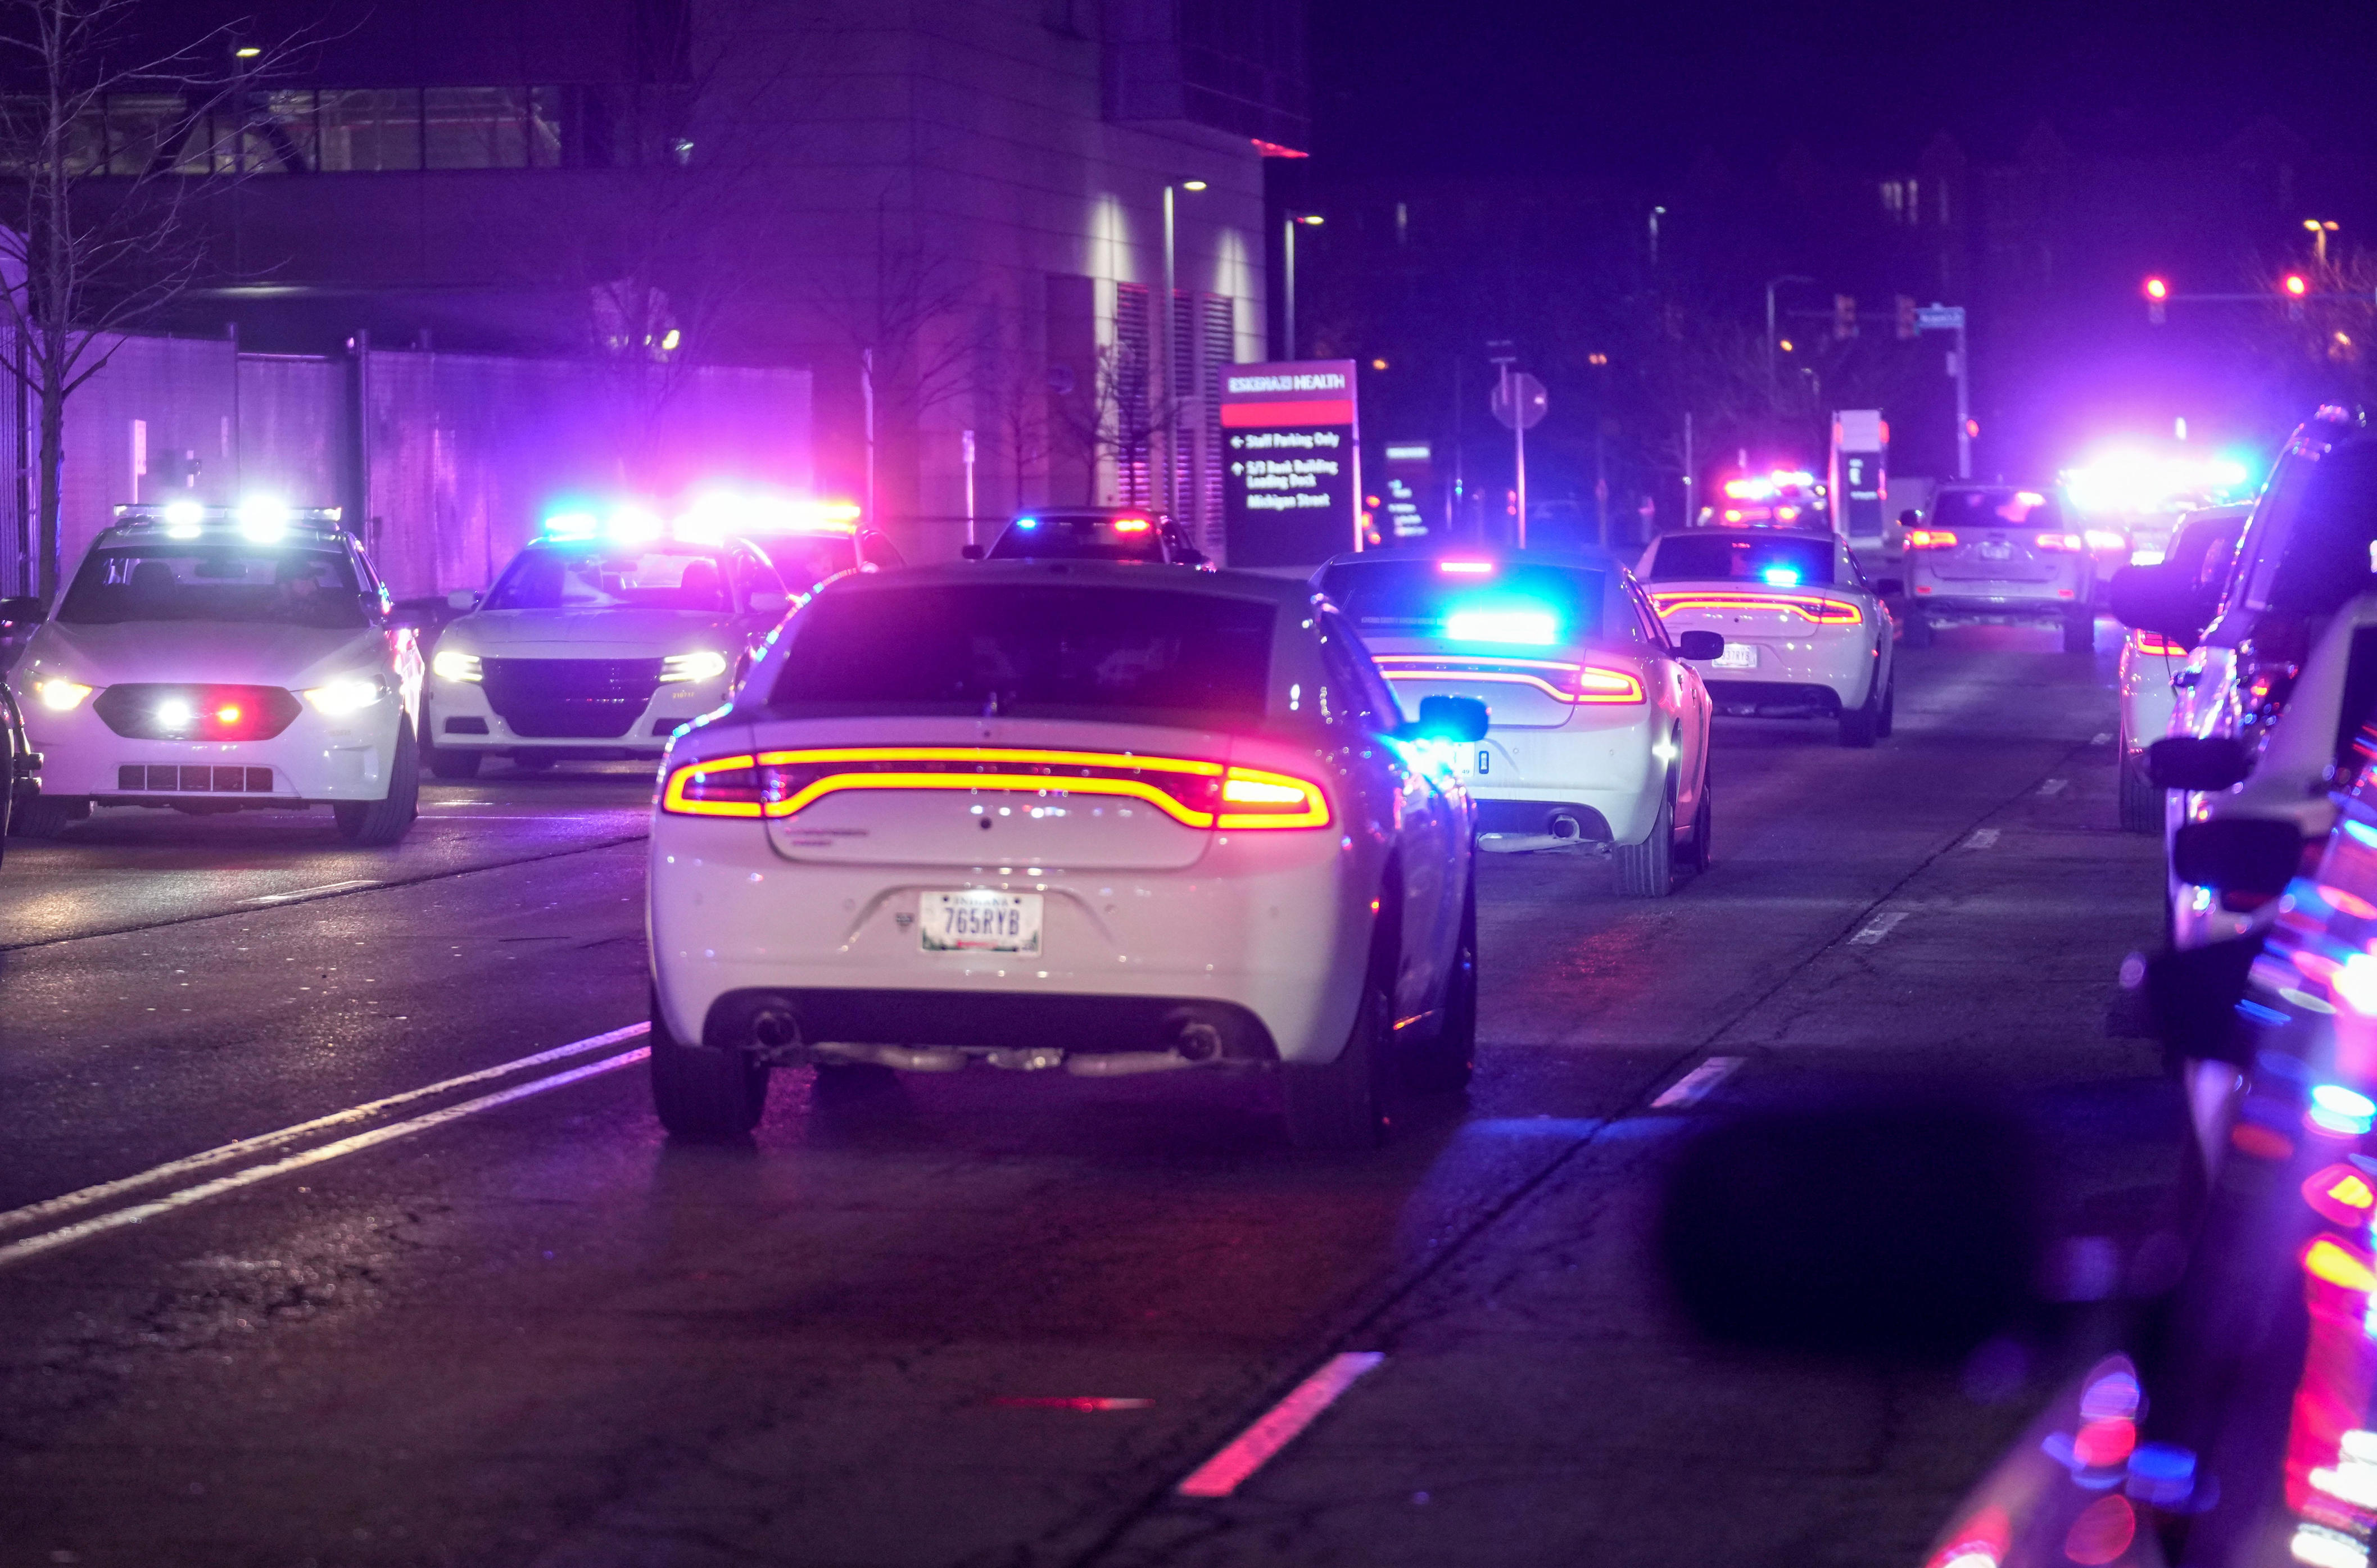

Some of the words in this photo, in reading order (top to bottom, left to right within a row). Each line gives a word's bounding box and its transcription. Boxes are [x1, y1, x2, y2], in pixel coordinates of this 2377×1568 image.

[1294, 374, 1345, 390] HEALTH
[1246, 434, 1273, 448] Staff
[1274, 433, 1314, 448] Parking
[1314, 432, 1339, 448] Only
[1293, 459, 1338, 475] Building
[1247, 474, 1288, 490] Loading
[1289, 473, 1316, 488] Dock
[1247, 494, 1296, 511] Michigan
[1297, 493, 1330, 507] Street
[945, 907, 1020, 935] 765RYB
